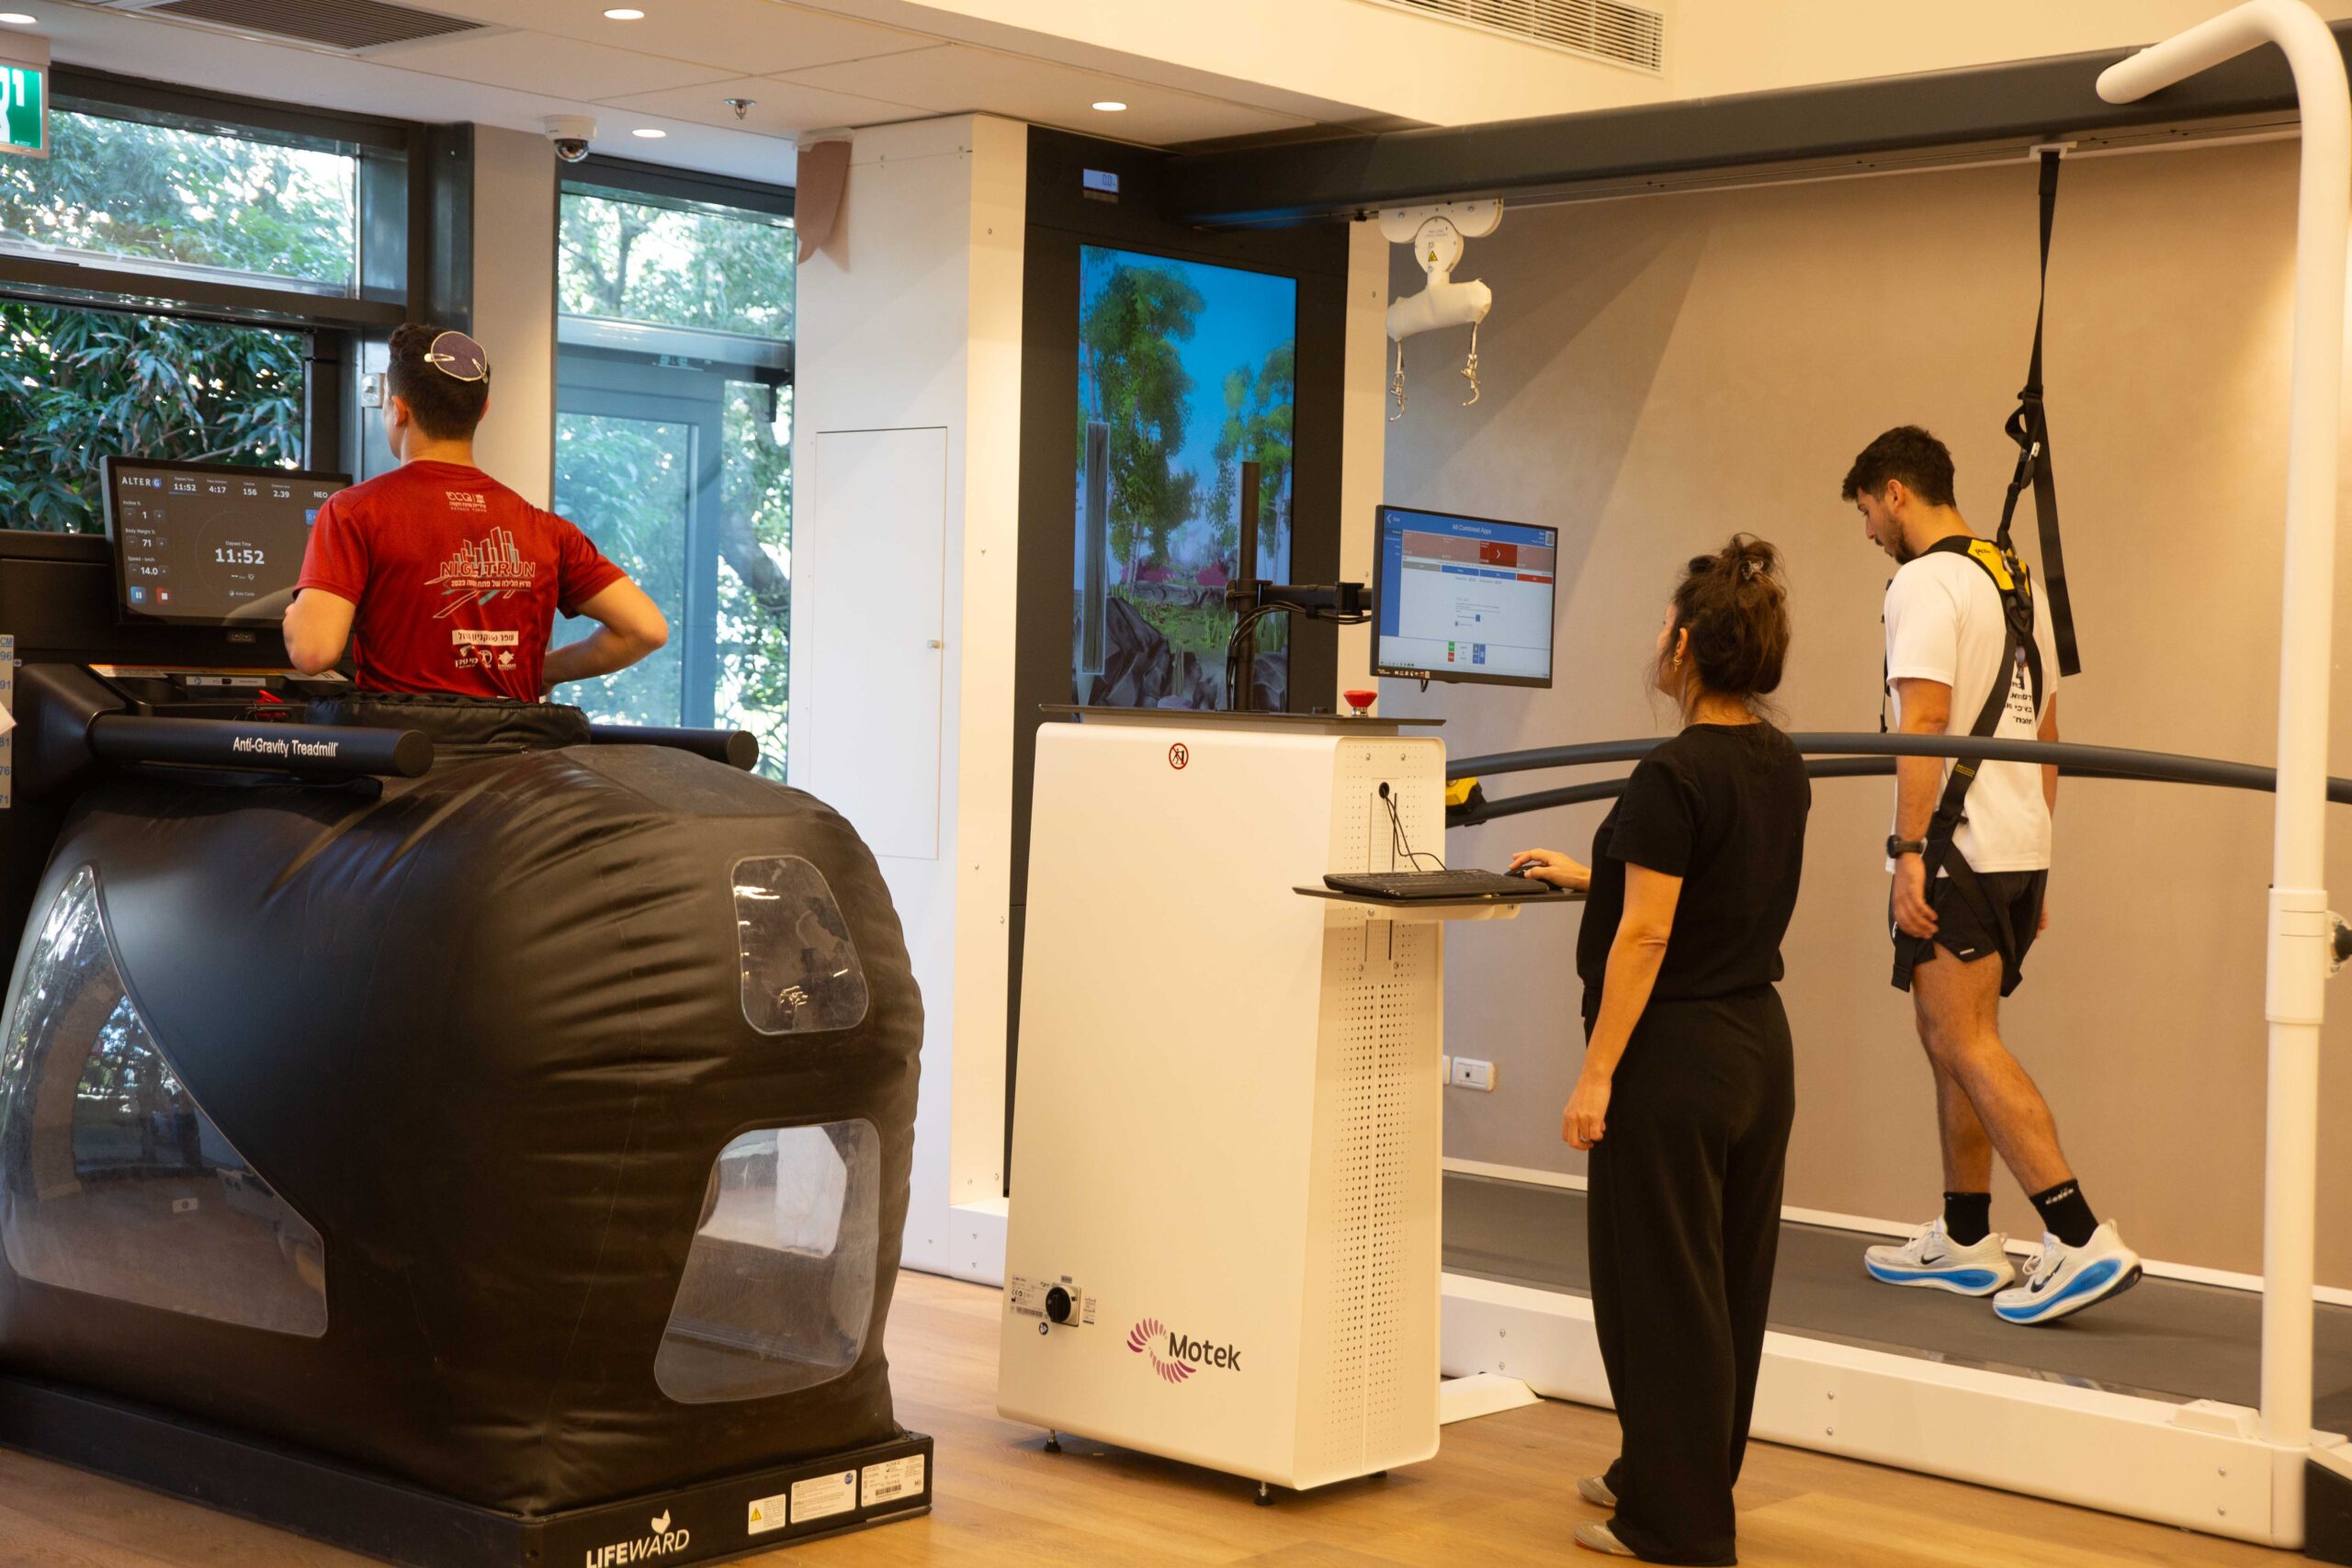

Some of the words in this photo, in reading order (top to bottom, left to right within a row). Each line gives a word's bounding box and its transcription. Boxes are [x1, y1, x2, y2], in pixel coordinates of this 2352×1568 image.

[174, 483, 197, 491] 11:52
[209, 485, 226, 493] 4:17
[243, 488, 257, 496] 156
[273, 490, 290, 498] 2.39
[313, 491, 328, 499] NEO
[142, 539, 152, 547] 71
[215, 548, 265, 565] 11:52
[141, 567, 158, 575] 14.0
[0, 680, 11, 688] 91
[232, 737, 289, 758] Anti-Gravity
[292, 739, 336, 758] Treadmill
[1169, 1332, 1241, 1371] Motek
[586, 1529, 690, 1568] LIFEWARD
